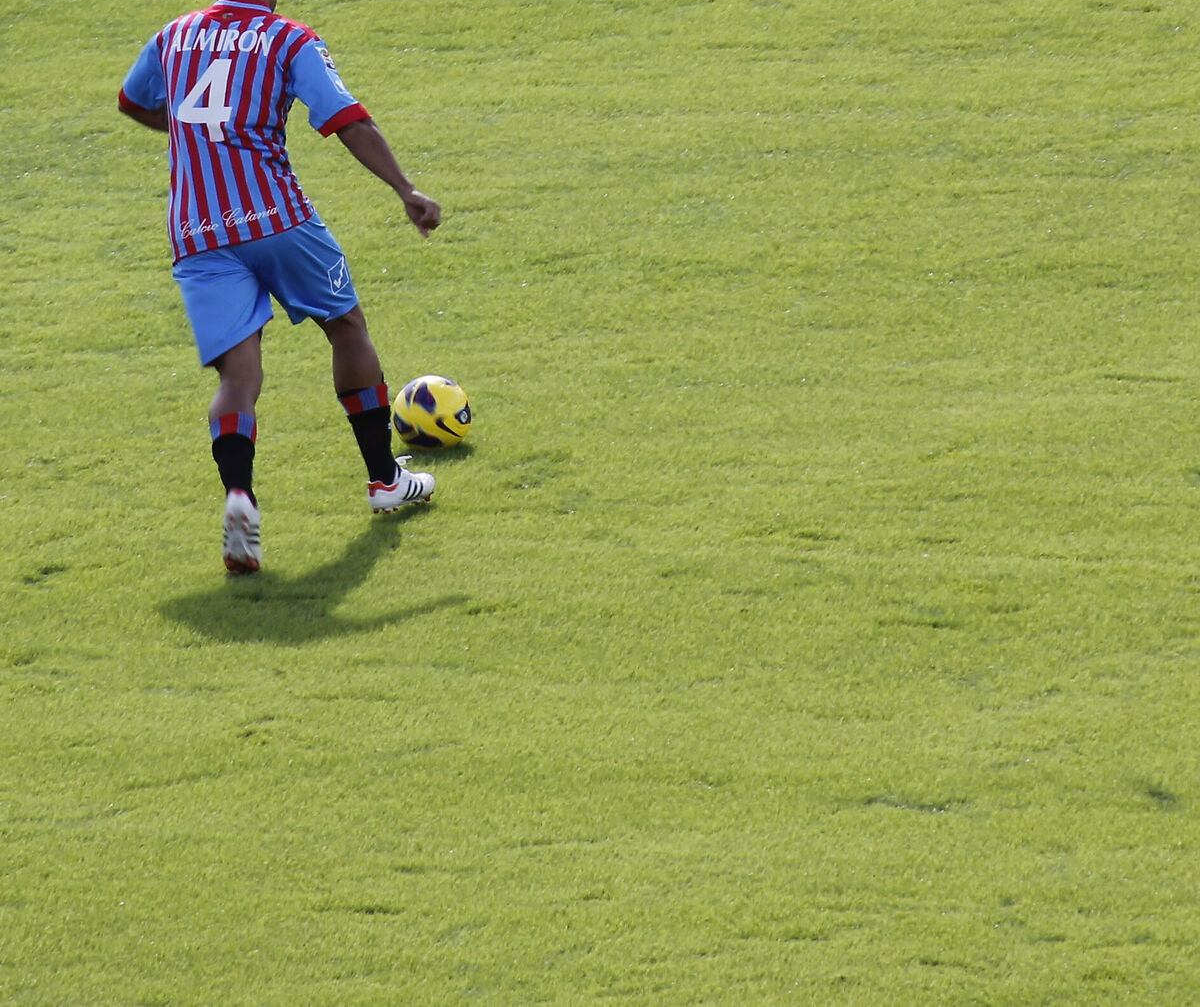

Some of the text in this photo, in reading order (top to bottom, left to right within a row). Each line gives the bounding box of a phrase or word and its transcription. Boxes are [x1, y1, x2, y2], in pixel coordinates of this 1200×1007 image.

[168, 22, 275, 57] ALMIRÓN
[177, 59, 233, 142] 4
[180, 205, 279, 239] Calcio Catania
